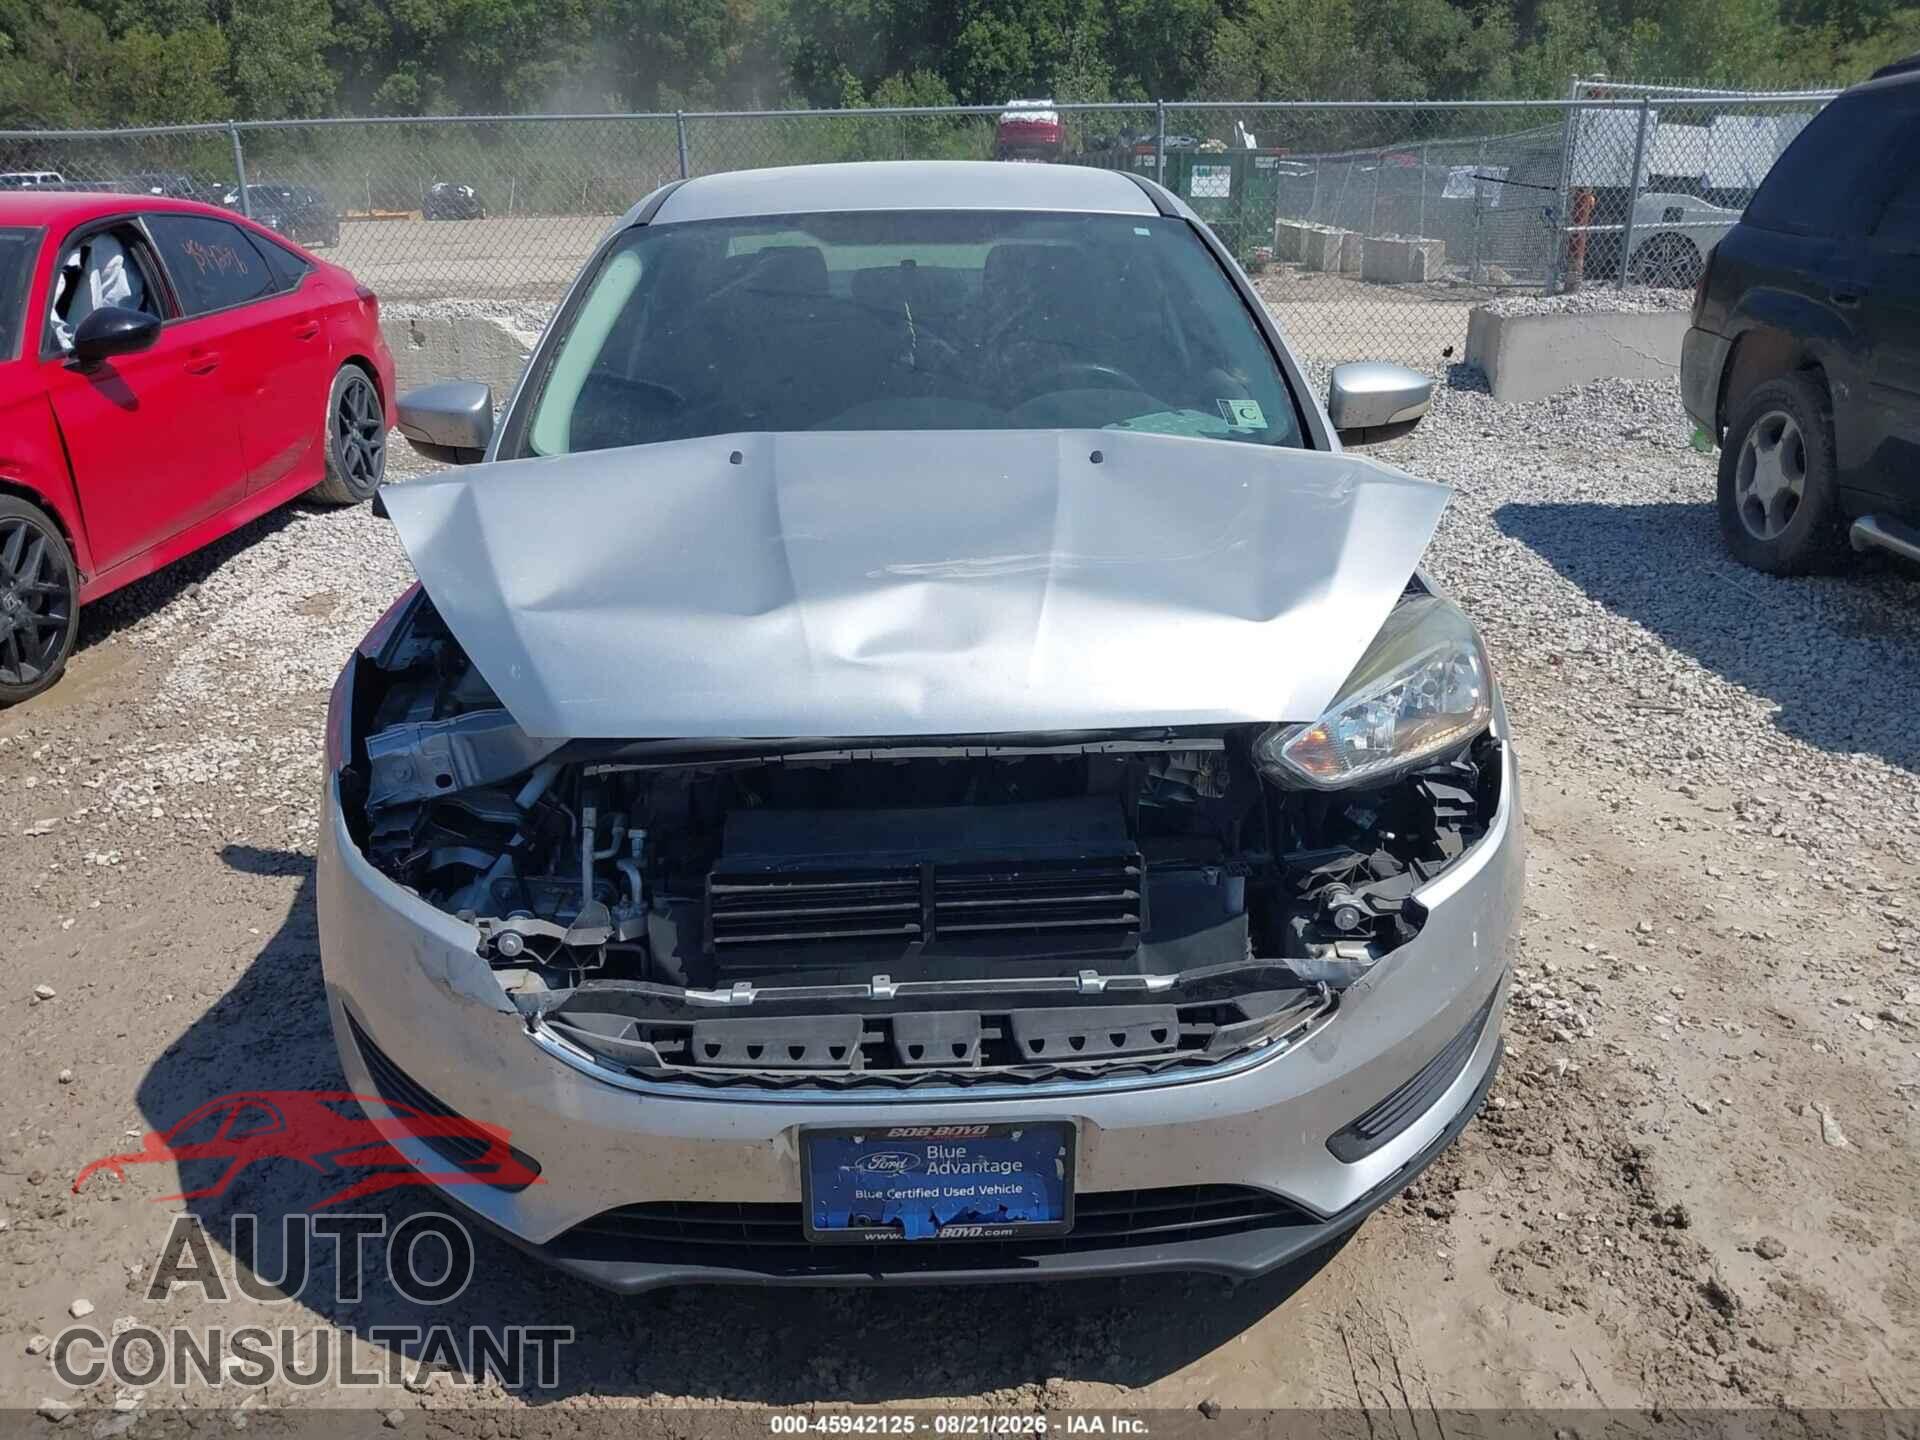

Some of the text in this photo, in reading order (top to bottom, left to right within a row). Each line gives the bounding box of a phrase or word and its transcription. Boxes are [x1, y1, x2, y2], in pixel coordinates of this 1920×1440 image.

[927, 1145, 967, 1159] Blue
[867, 1154, 909, 1171] Ford
[926, 1159, 1023, 1176] Advantage
[855, 1184, 1023, 1200] Blue Certified Used Vehicle
[1239, 1407, 1257, 1420] C
